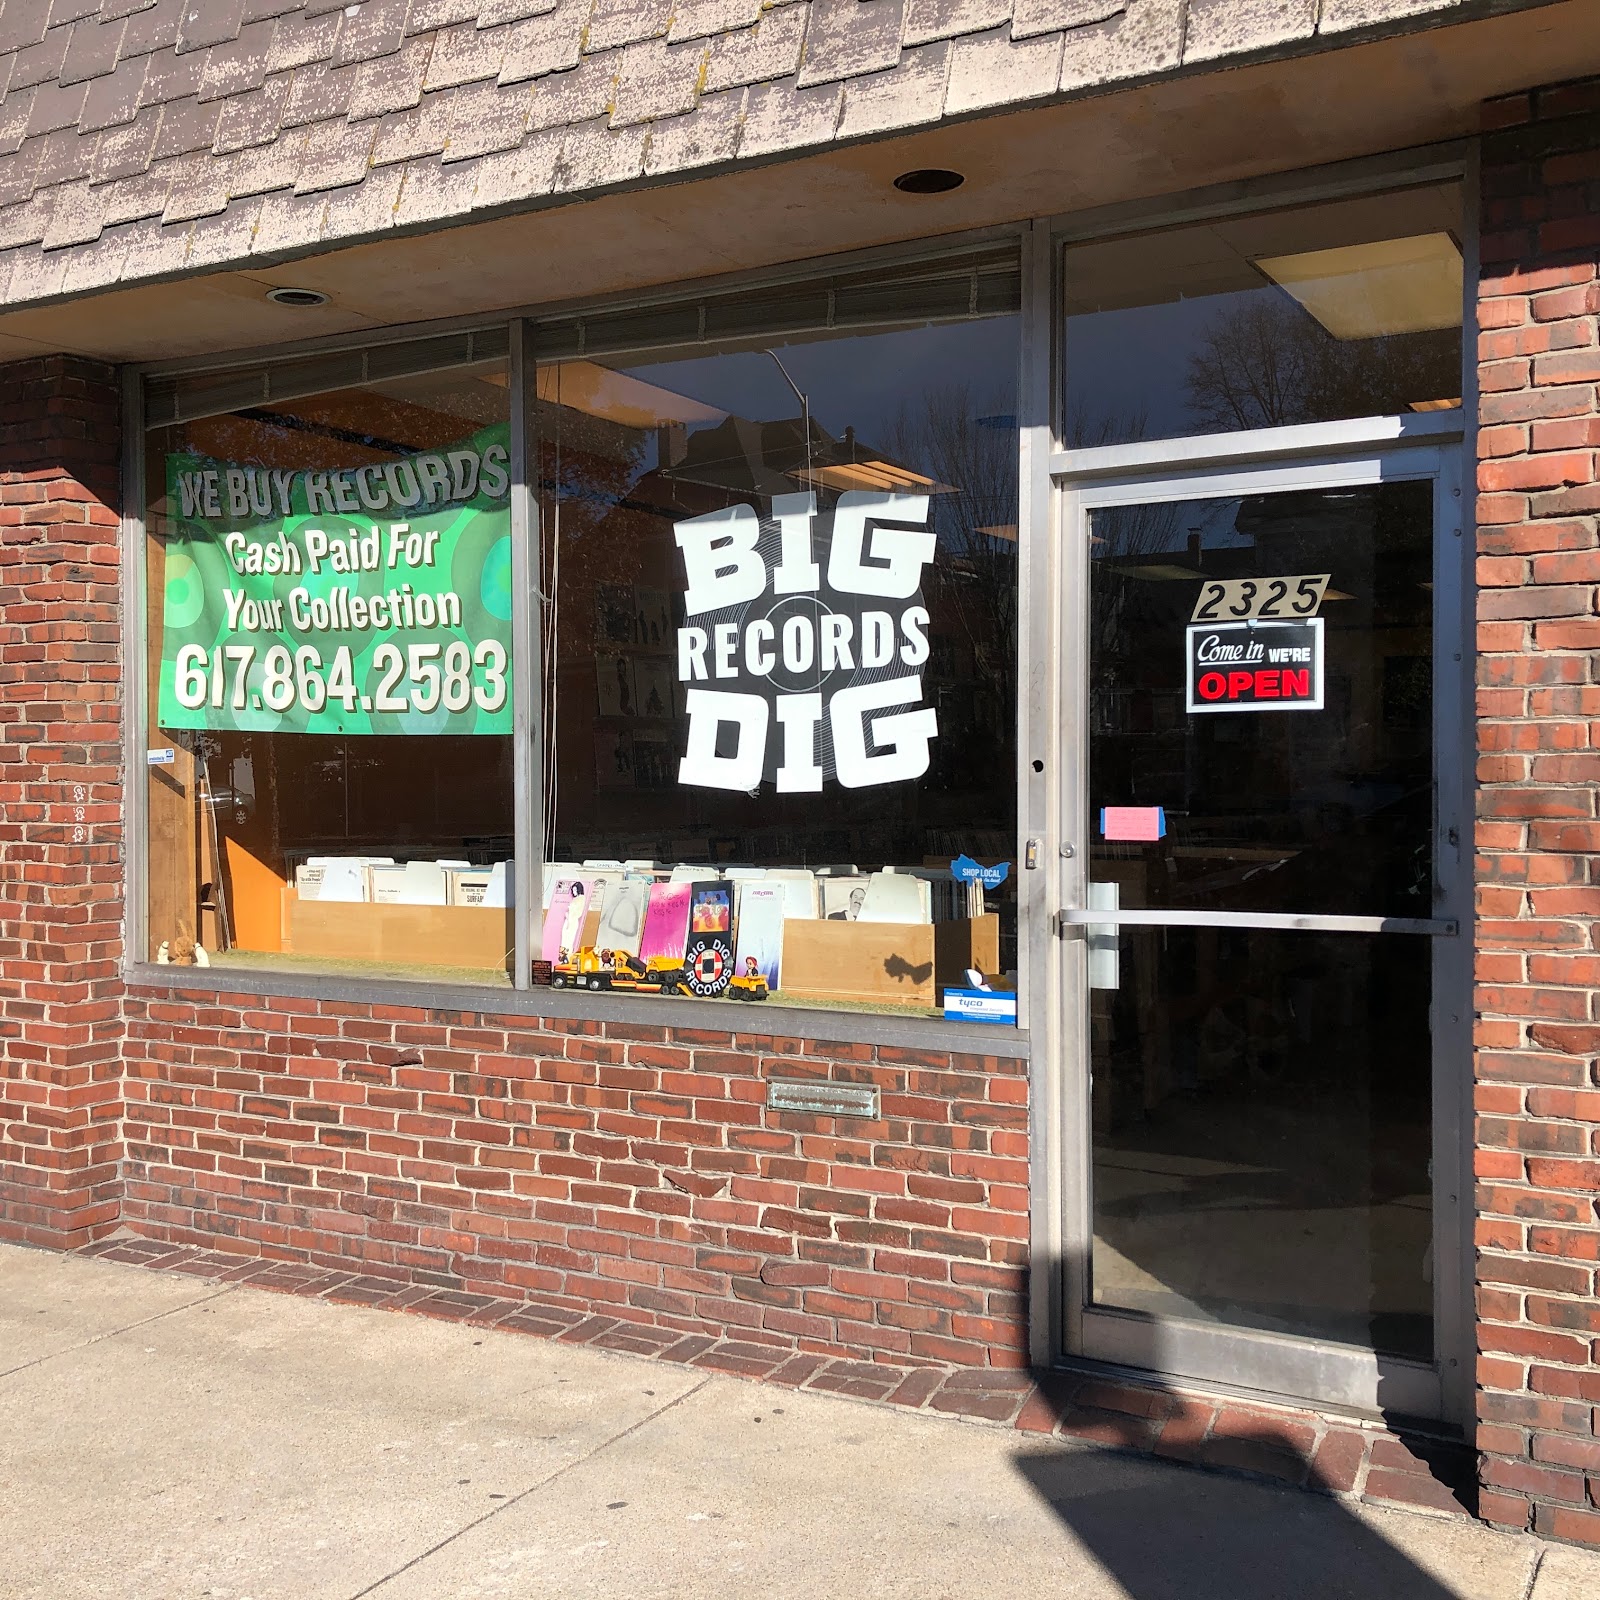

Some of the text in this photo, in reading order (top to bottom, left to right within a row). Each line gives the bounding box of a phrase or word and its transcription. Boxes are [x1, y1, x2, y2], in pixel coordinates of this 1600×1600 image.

[178, 444, 511, 518] WE BUY RECORDS
[225, 523, 440, 575] Cash Paid For
[673, 490, 937, 616] BIG
[222, 583, 462, 632] Your Collection
[1197, 578, 1323, 618] 2325
[677, 606, 931, 681] RECORDS
[1197, 635, 1311, 663] Come in WE'RE
[174, 638, 508, 714] 617.864.2583
[1198, 669, 1310, 700] OPEN
[677, 674, 938, 793] DIG
[962, 868, 1001, 878] SHOP LOCAL
[687, 938, 731, 964] BIG DIG
[686, 968, 732, 996] RECORDS
[959, 998, 983, 1008] tyco
